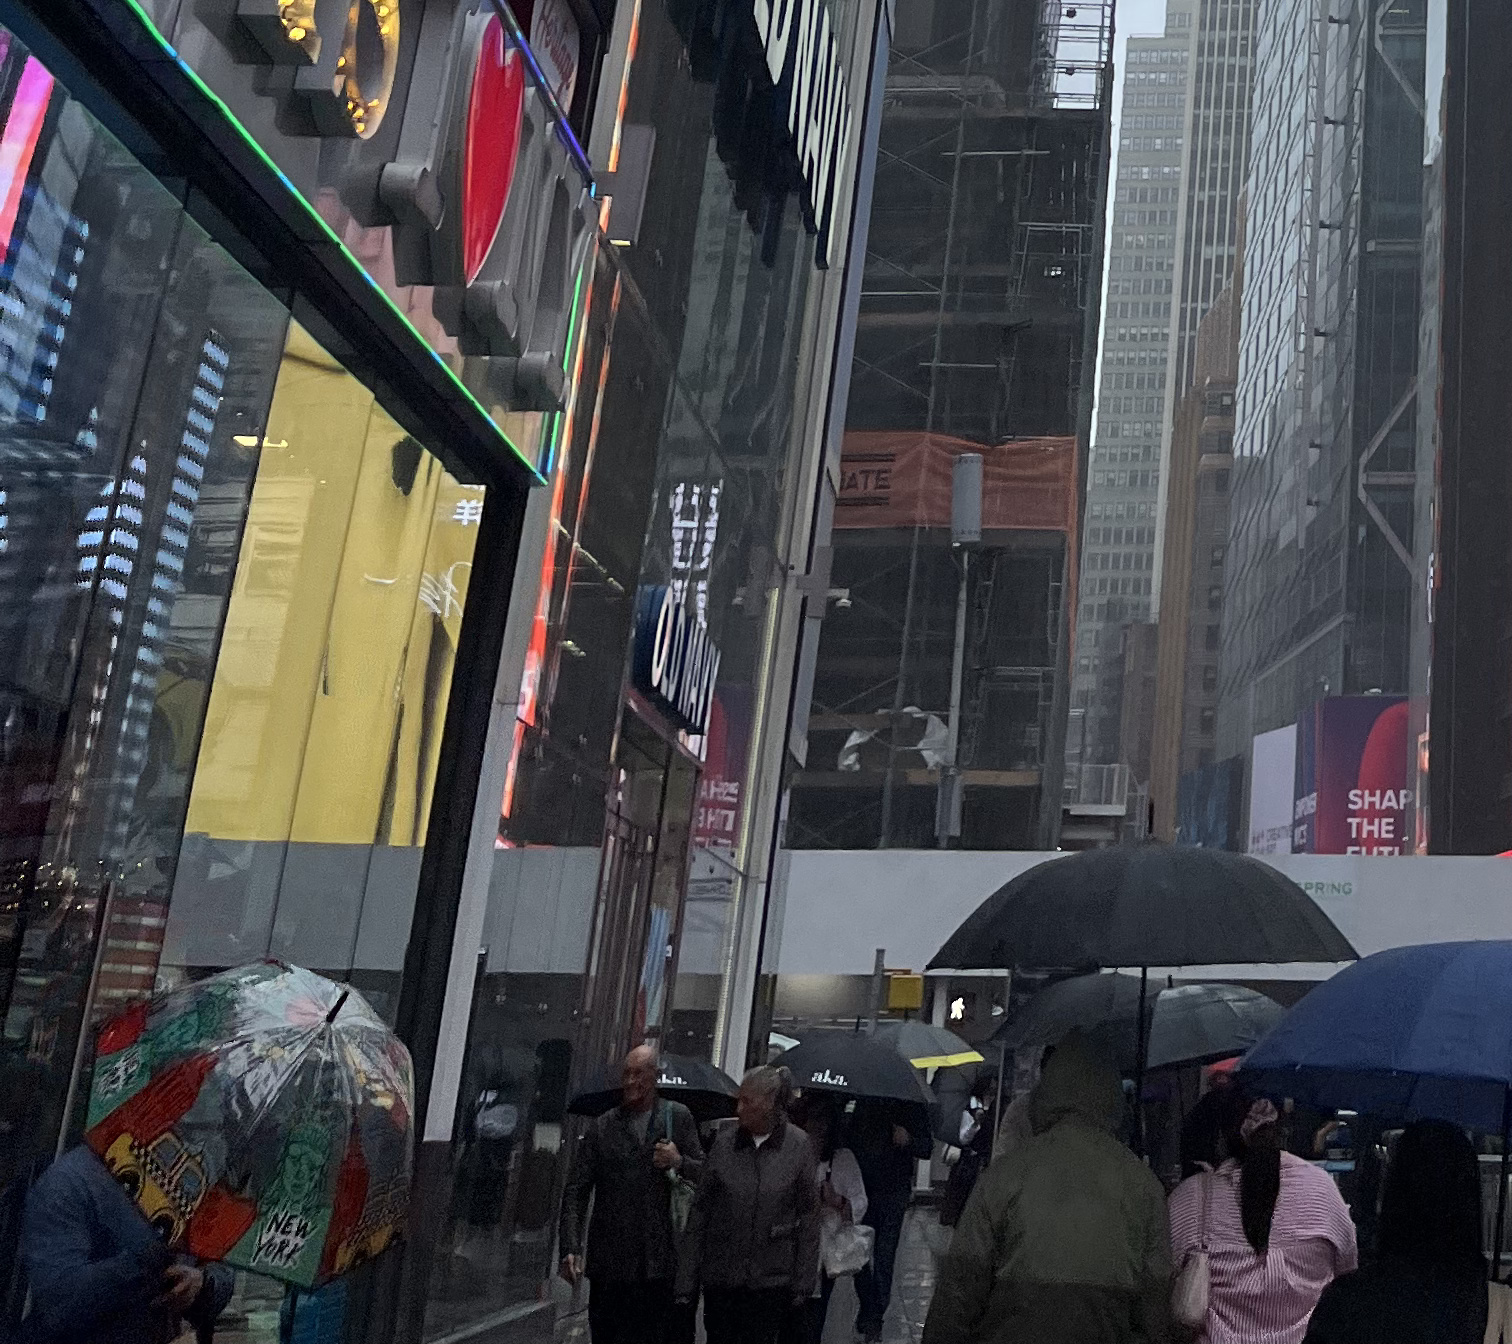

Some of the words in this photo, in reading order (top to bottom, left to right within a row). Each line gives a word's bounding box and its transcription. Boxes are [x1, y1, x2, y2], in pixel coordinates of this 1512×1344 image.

[1346, 817, 1395, 839] THE
[1297, 881, 1353, 896] PRING
[266, 1212, 310, 1236] NEW
